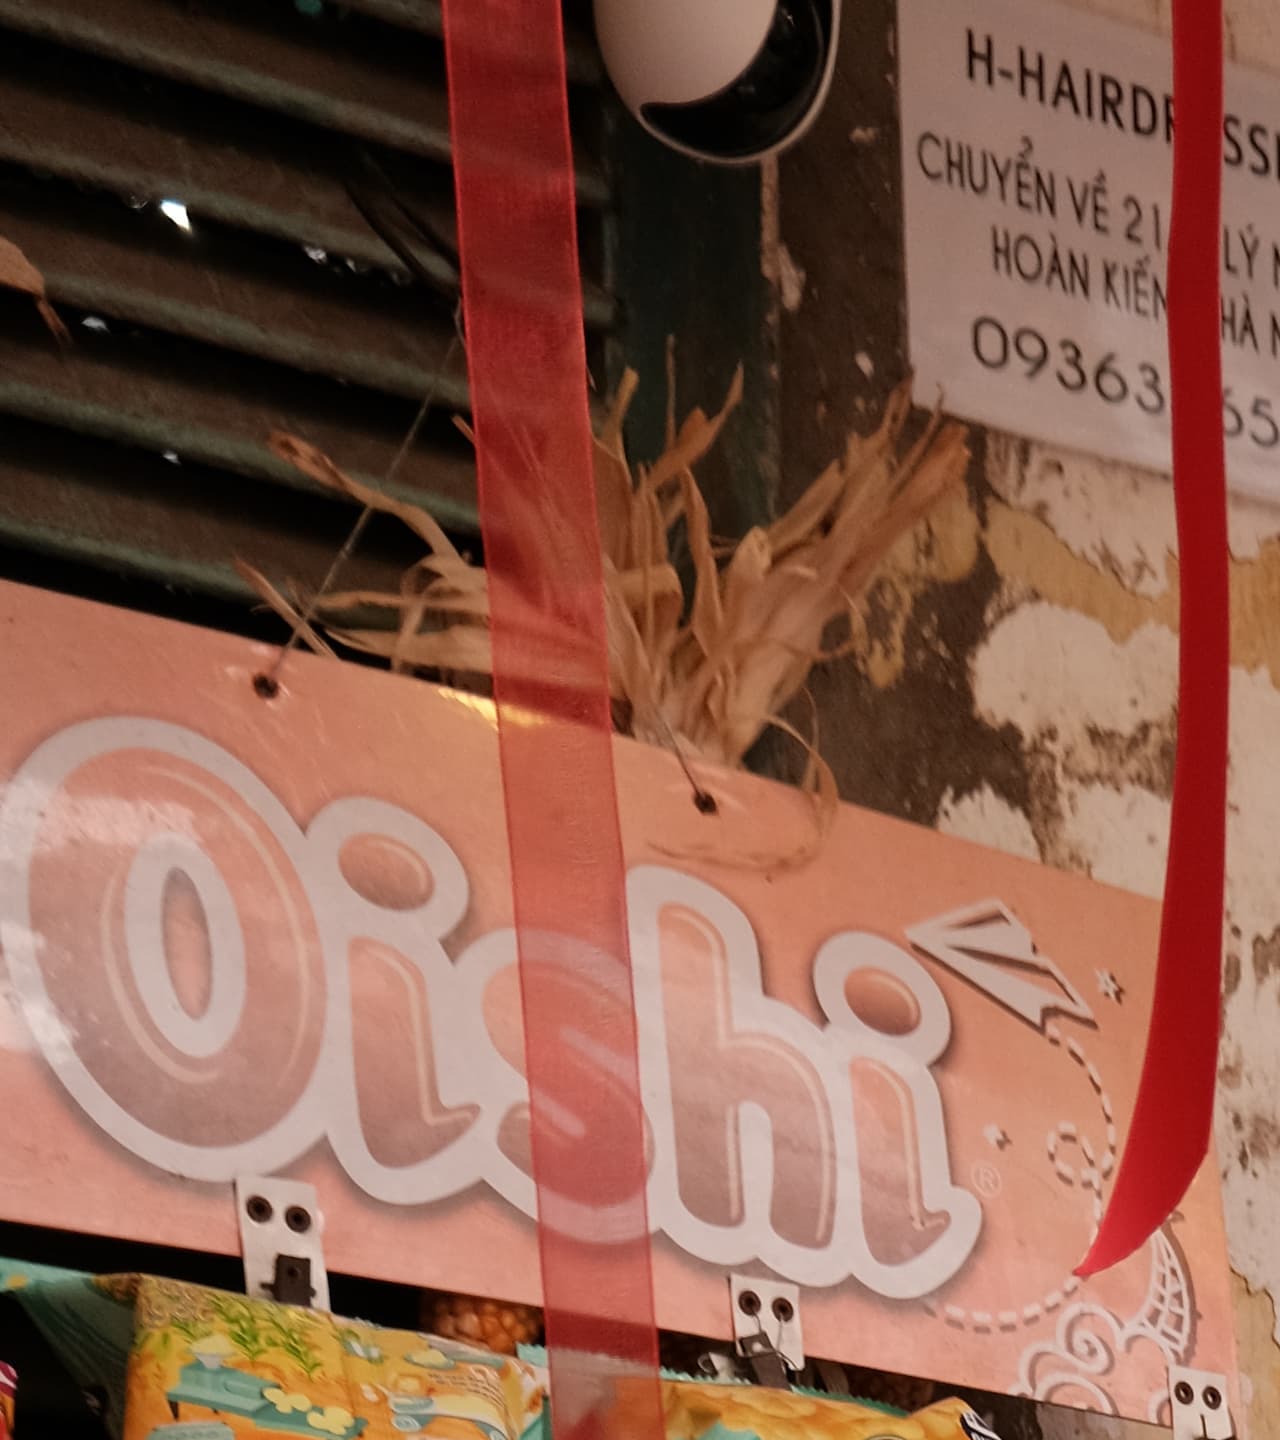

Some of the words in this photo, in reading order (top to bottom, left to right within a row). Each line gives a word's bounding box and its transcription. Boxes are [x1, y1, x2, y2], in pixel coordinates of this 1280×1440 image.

[917, 131, 1056, 217] CHUYỂN
[1068, 168, 1109, 233] VỀ
[1223, 222, 1260, 278] LÝ
[991, 223, 1090, 298] HOÀN
[1219, 292, 1259, 350] HÀ
[0, 716, 983, 1300] Oishi
